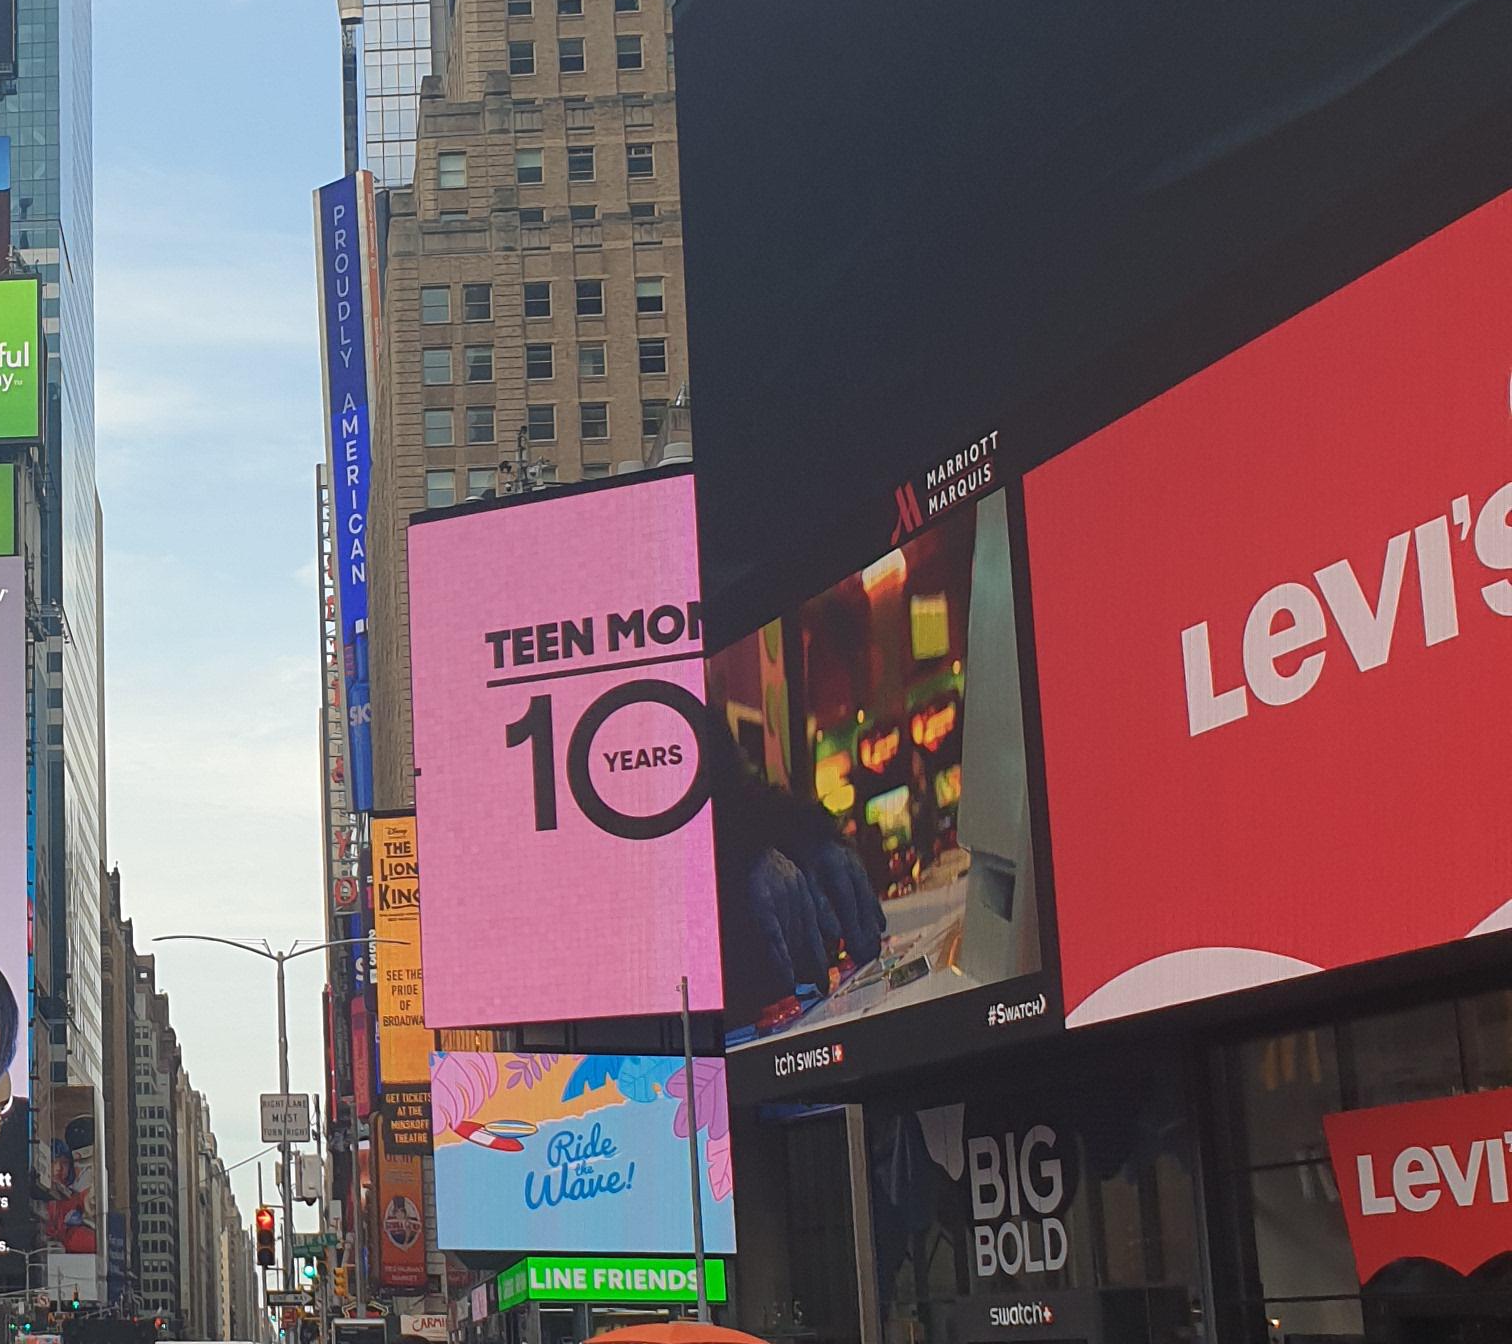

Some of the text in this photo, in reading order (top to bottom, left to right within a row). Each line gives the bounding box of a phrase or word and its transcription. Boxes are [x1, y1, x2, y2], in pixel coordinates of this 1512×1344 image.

[333, 205, 353, 369] PROUDLY
[926, 430, 999, 490] MARRIOTT
[341, 393, 365, 585] AMERICAN
[928, 463, 992, 516] MARQUIS
[485, 617, 594, 669] TEEN
[505, 678, 712, 841] 10
[603, 744, 683, 773] YEARS
[384, 840, 412, 855] THE
[386, 969, 422, 981] SEE THE
[391, 984, 418, 995] PRIDE
[399, 1000, 411, 1011] OF
[383, 1015, 424, 1027] BROADWA
[272, 1113, 297, 1123] MUST
[408, 1106, 423, 1116] THE
[286, 1128, 308, 1136] RIGHT
[547, 1122, 617, 1168] Ride
[575, 1160, 594, 1177] the
[967, 1124, 1064, 1220] BIG
[524, 1161, 636, 1210] Wave!
[974, 1217, 1068, 1277] BOLD
[529, 1267, 587, 1289] LINE
[593, 1267, 698, 1292] FRIENDS
[990, 1301, 1043, 1326] swatch
